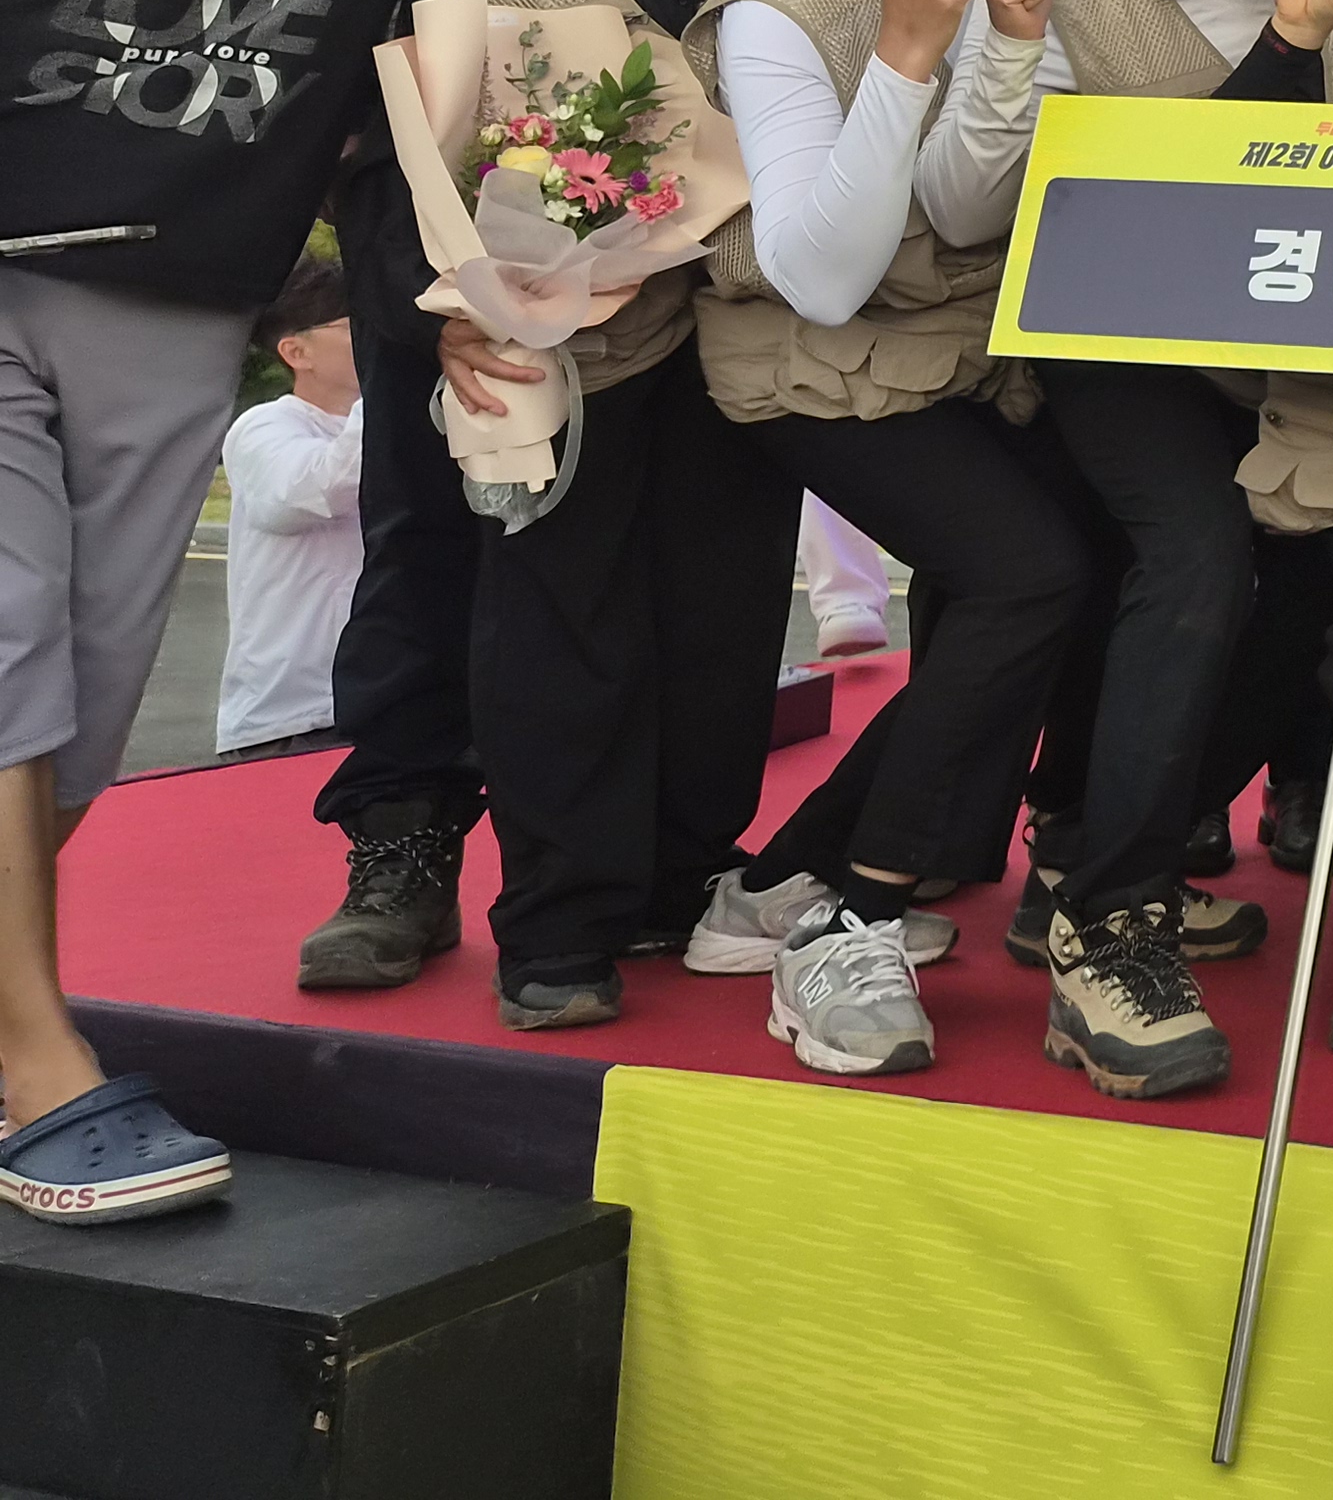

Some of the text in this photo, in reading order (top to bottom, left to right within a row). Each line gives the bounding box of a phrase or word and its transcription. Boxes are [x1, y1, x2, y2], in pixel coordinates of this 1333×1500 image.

[121, 45, 195, 64] pur
[1239, 141, 1317, 171] 제2회
[19, 1181, 97, 1210] crocs
